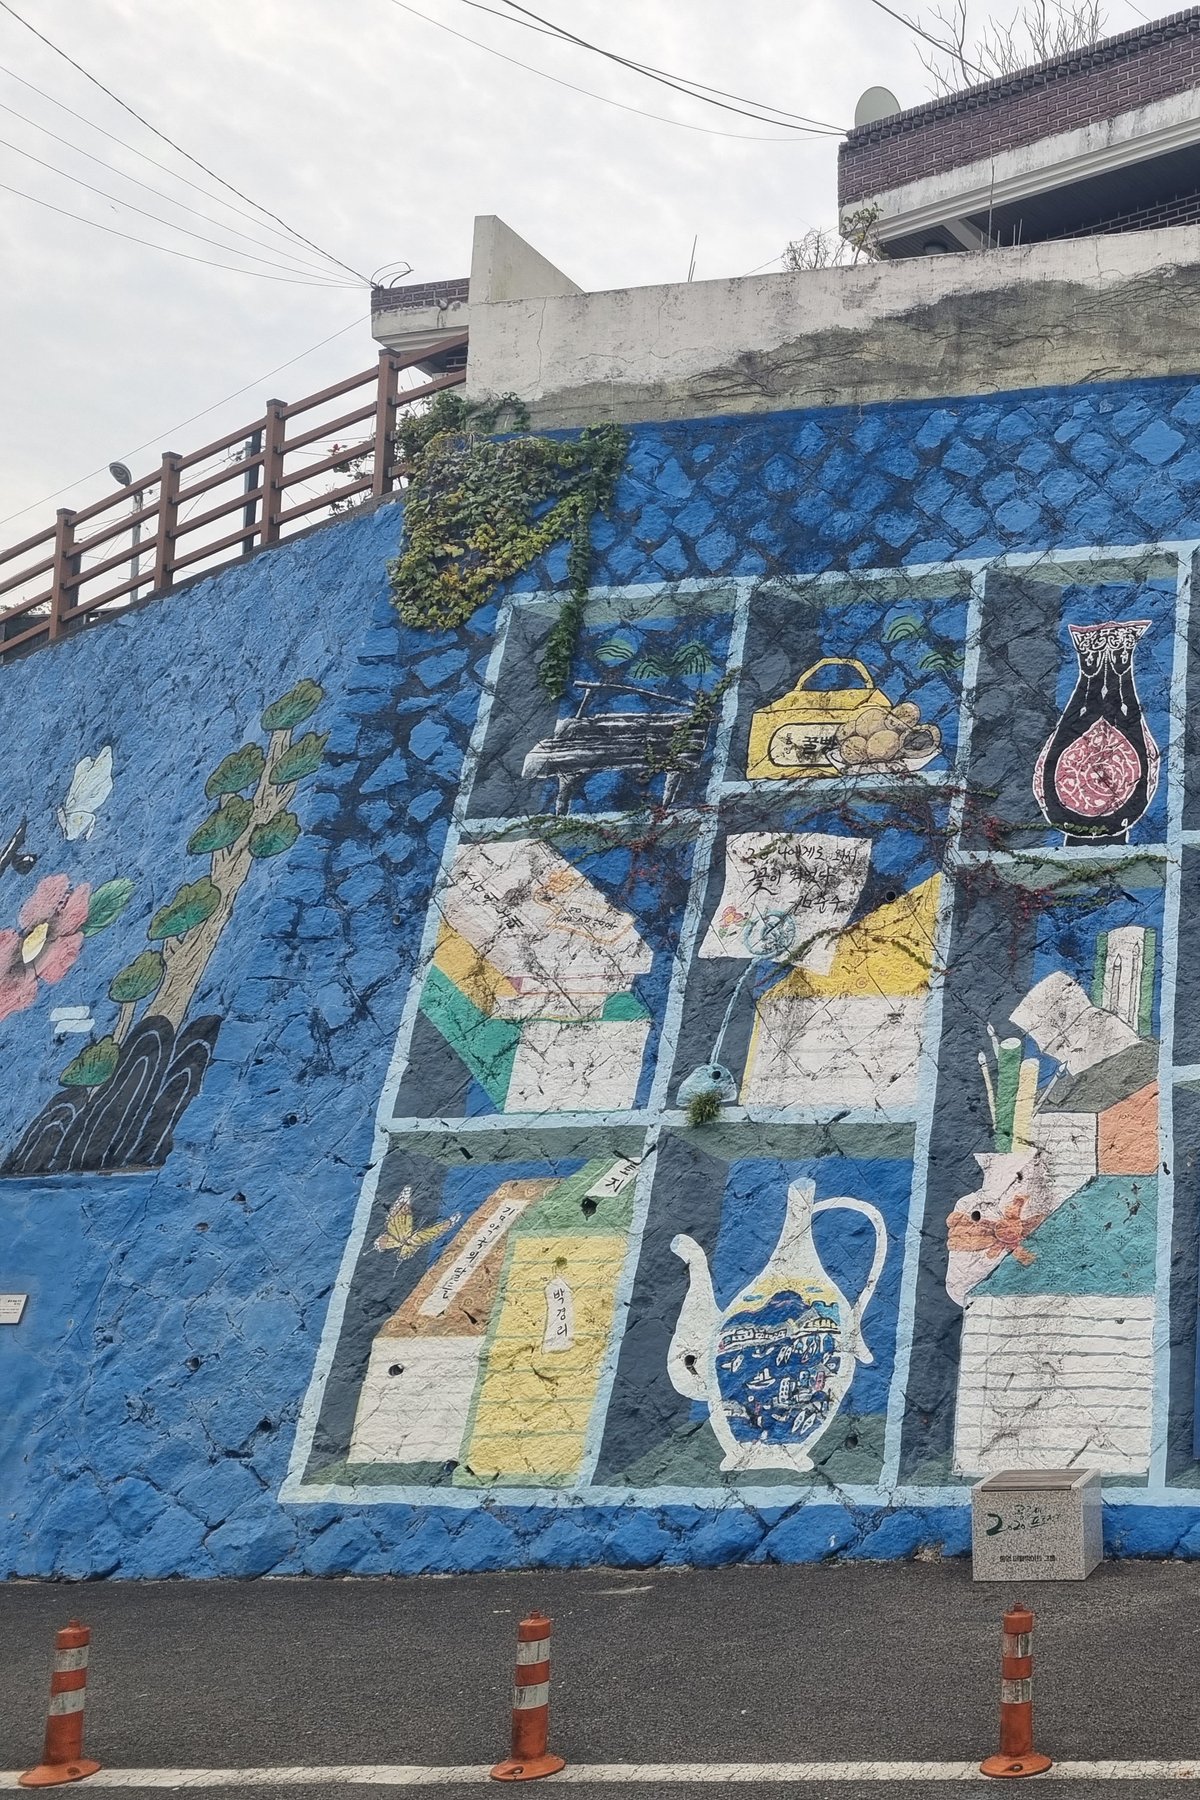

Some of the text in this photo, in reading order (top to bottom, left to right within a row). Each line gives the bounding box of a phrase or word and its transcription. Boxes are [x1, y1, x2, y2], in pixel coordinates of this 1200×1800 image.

[743, 867, 781, 904] 꽃이
[789, 892, 843, 915] 김춘수
[605, 1164, 636, 1192] 토지
[443, 1207, 515, 1298] 김약국의 딸들
[553, 1288, 567, 1336] 박경리
[986, 1513, 1025, 1536] 2020
